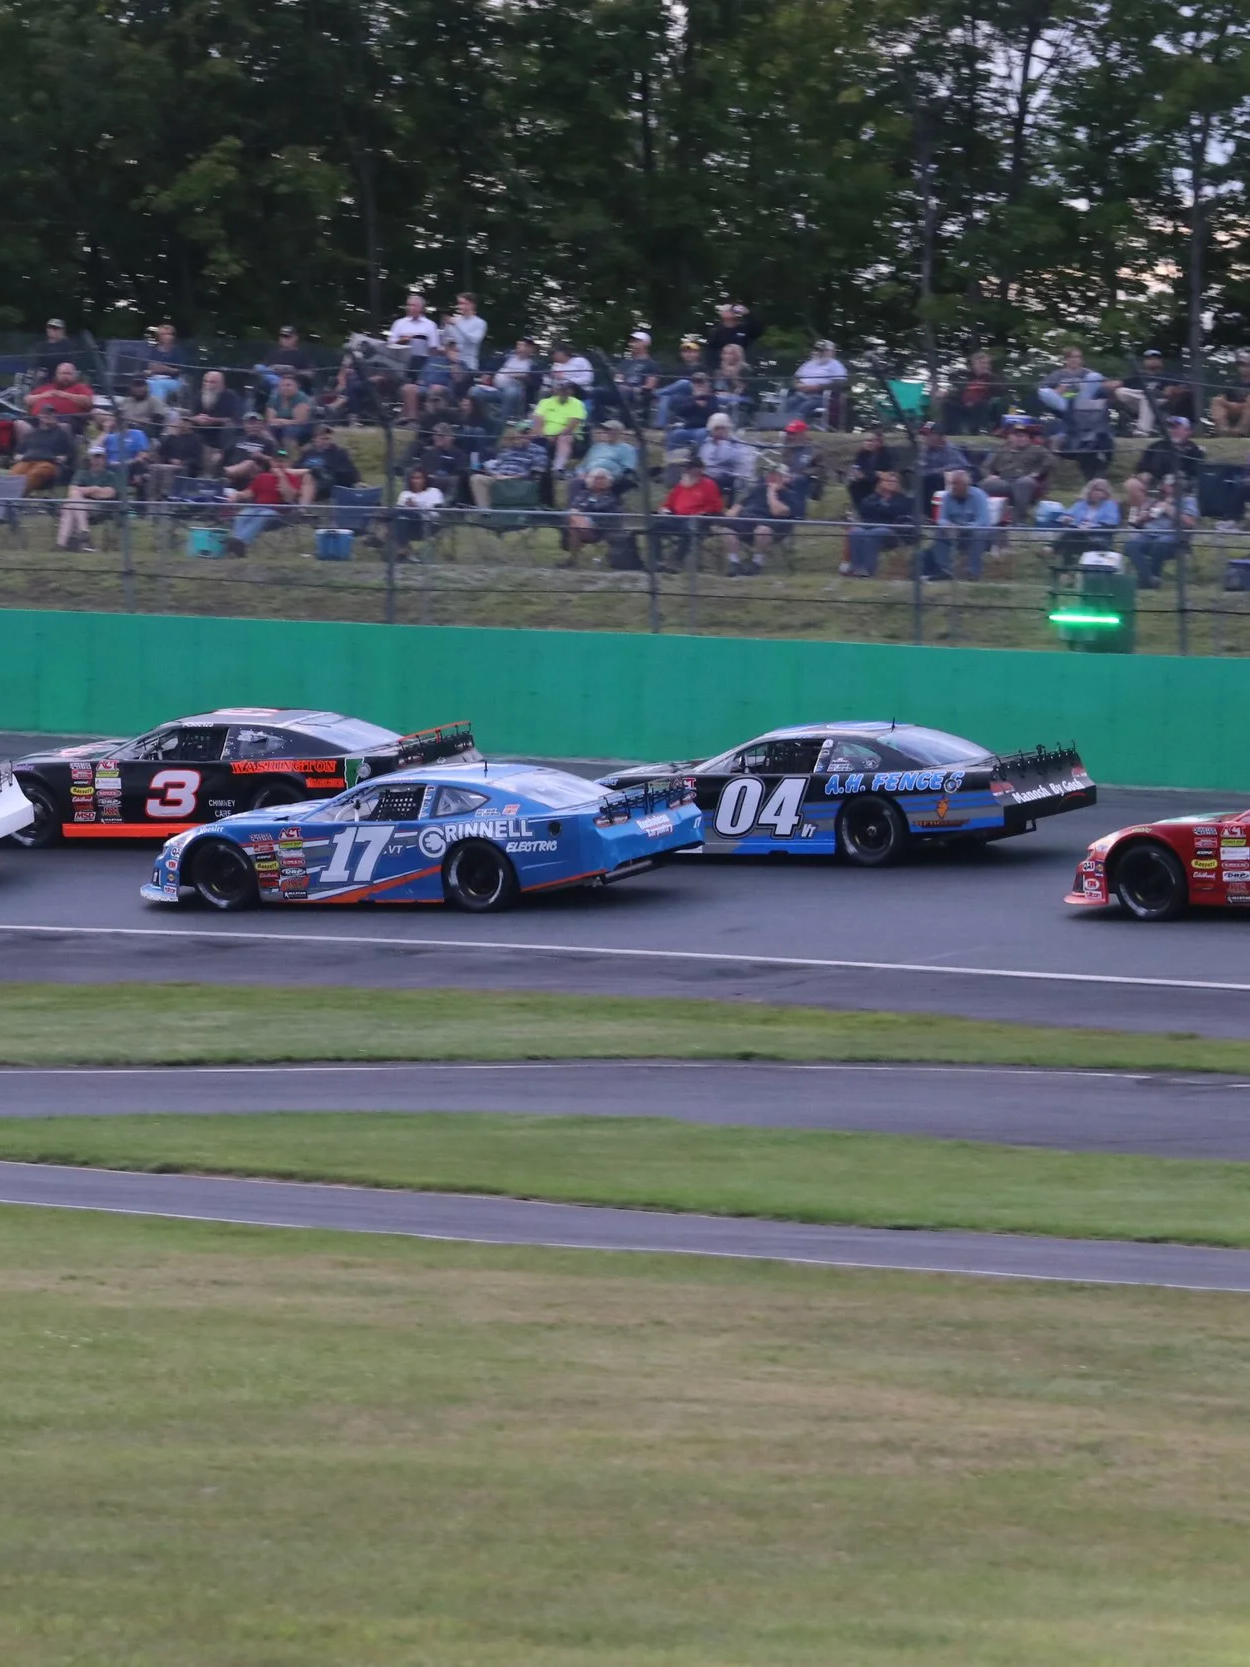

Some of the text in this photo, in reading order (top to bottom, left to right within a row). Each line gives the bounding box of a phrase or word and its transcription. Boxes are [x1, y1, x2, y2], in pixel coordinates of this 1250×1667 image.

[97, 760, 119, 770] ACT
[231, 760, 337, 774] WASHINGTON
[871, 770, 947, 791] FENCE
[1012, 778, 1086, 804] Manosh By Gosh
[145, 769, 202, 818] 3
[714, 776, 808, 837] 04
[279, 826, 302, 839] ACT
[319, 825, 396, 883] 17
[505, 840, 558, 853] ELECTRIC
